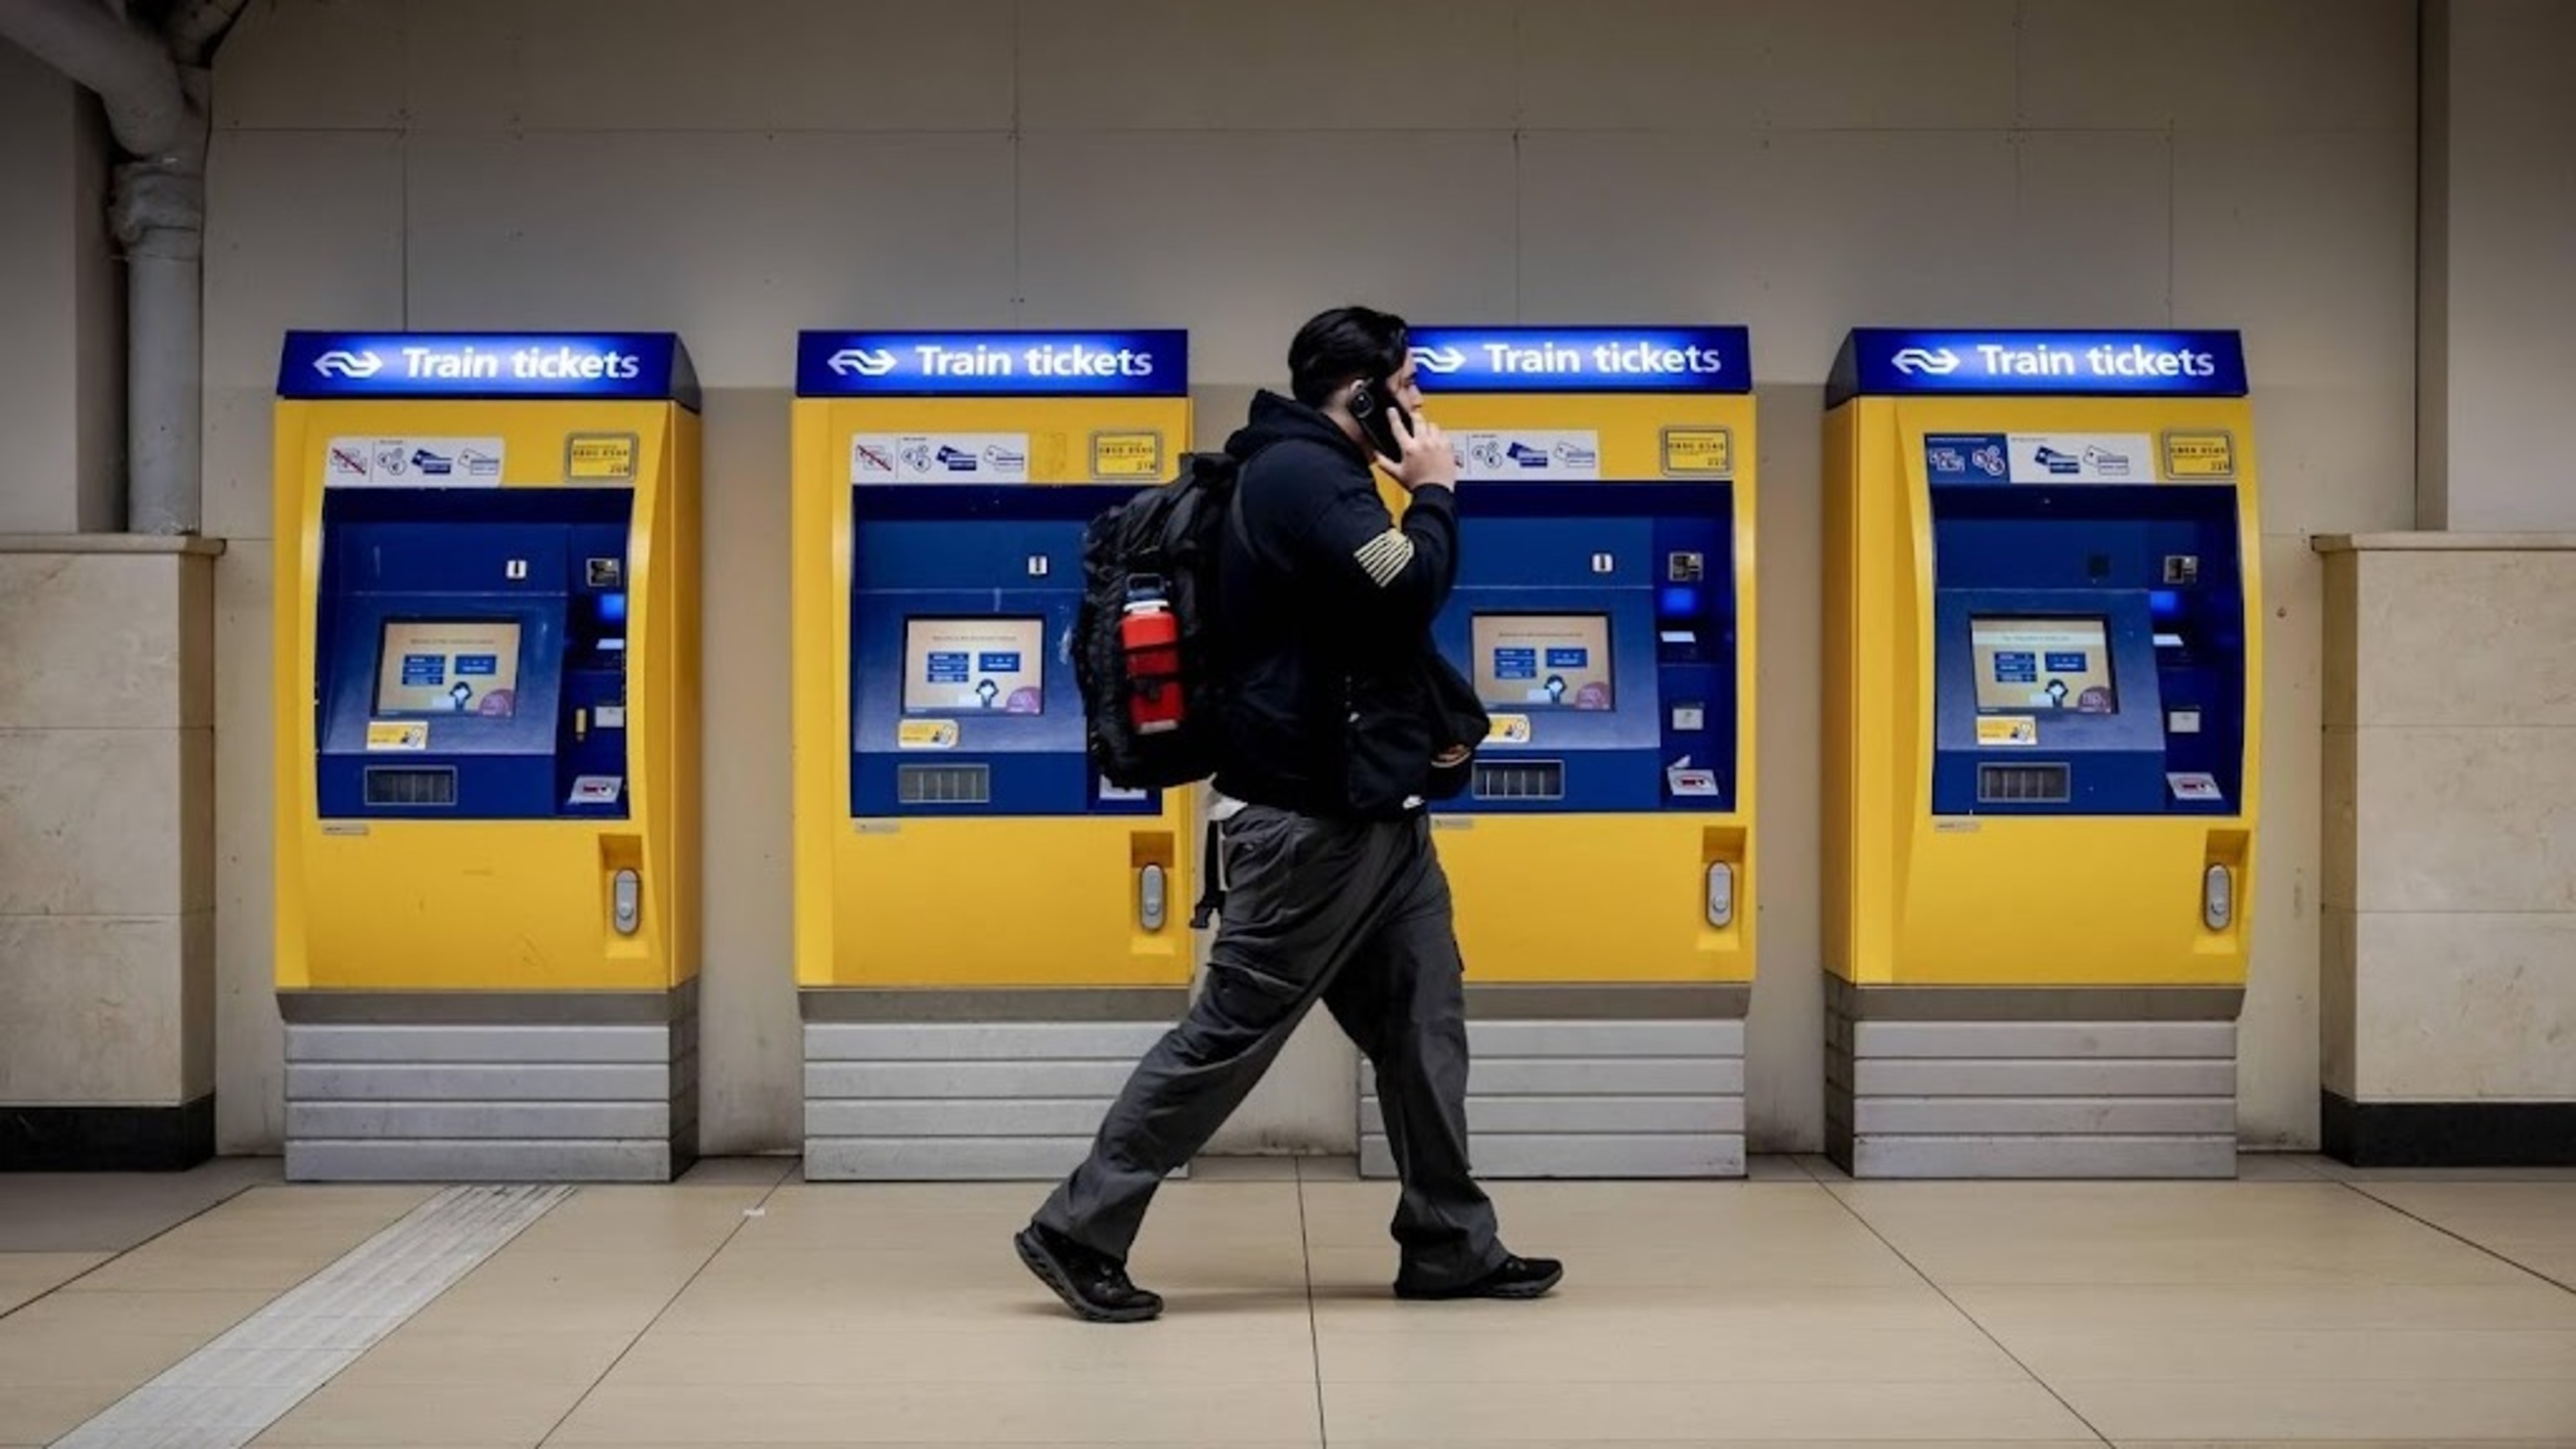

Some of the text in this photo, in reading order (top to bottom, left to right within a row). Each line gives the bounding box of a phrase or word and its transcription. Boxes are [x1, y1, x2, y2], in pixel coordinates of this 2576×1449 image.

[402, 346, 640, 379] Train tickets
[916, 344, 1153, 376] Train tickets
[1483, 341, 1721, 374] Train tickets
[1977, 344, 2215, 376] Train tickets
